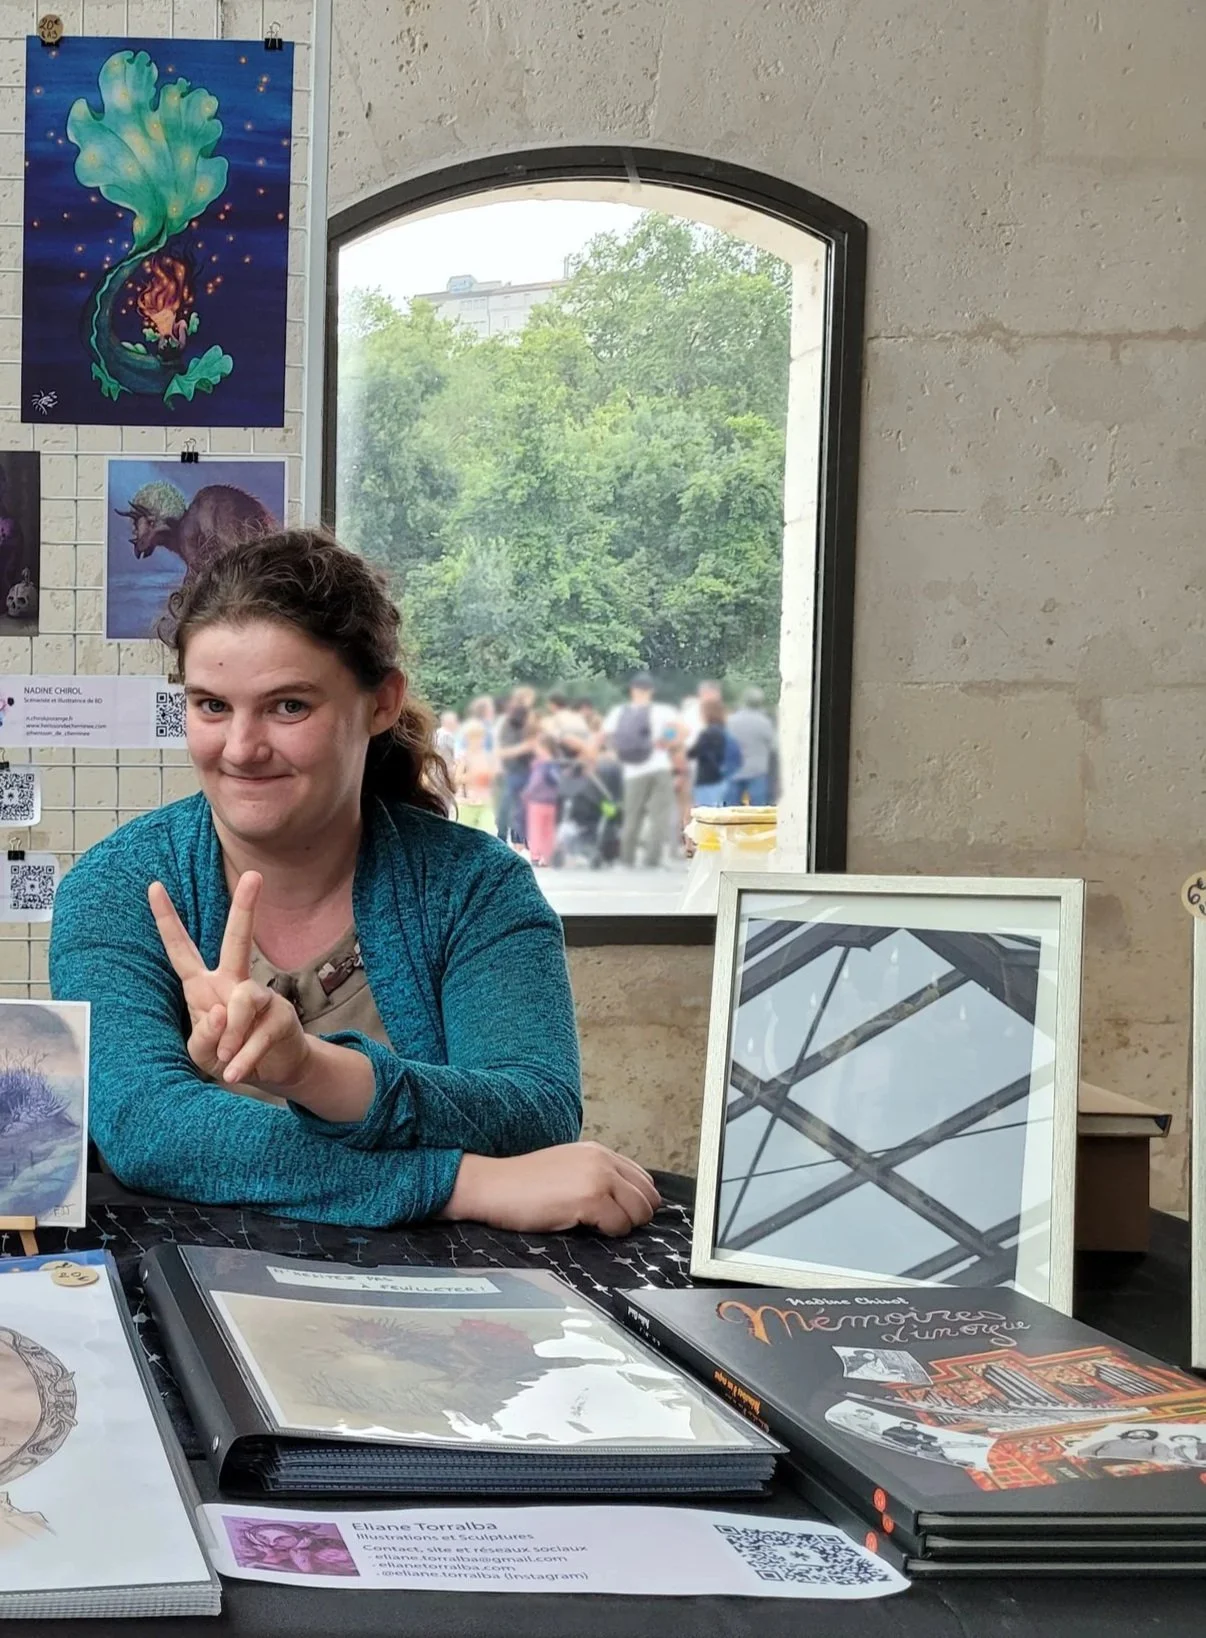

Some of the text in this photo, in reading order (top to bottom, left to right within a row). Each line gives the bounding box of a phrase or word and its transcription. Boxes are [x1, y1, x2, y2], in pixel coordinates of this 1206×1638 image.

[55, 687, 83, 695] CHIROL
[715, 1300, 1006, 1346] Mémoires
[960, 1320, 1031, 1347] orgue
[352, 1520, 498, 1532] Eliane Torralba
[356, 1533, 440, 1541] Illustrations
[458, 1533, 535, 1542] Sculptures
[426, 1545, 452, 1553] site
[474, 1545, 530, 1553] réseaux
[533, 1544, 588, 1553] sociaux
[375, 1554, 568, 1563] eliane.torralba@gmail.com
[378, 1561, 517, 1571] elianetorralba.com
[503, 1571, 589, 1581] (Instagram)
